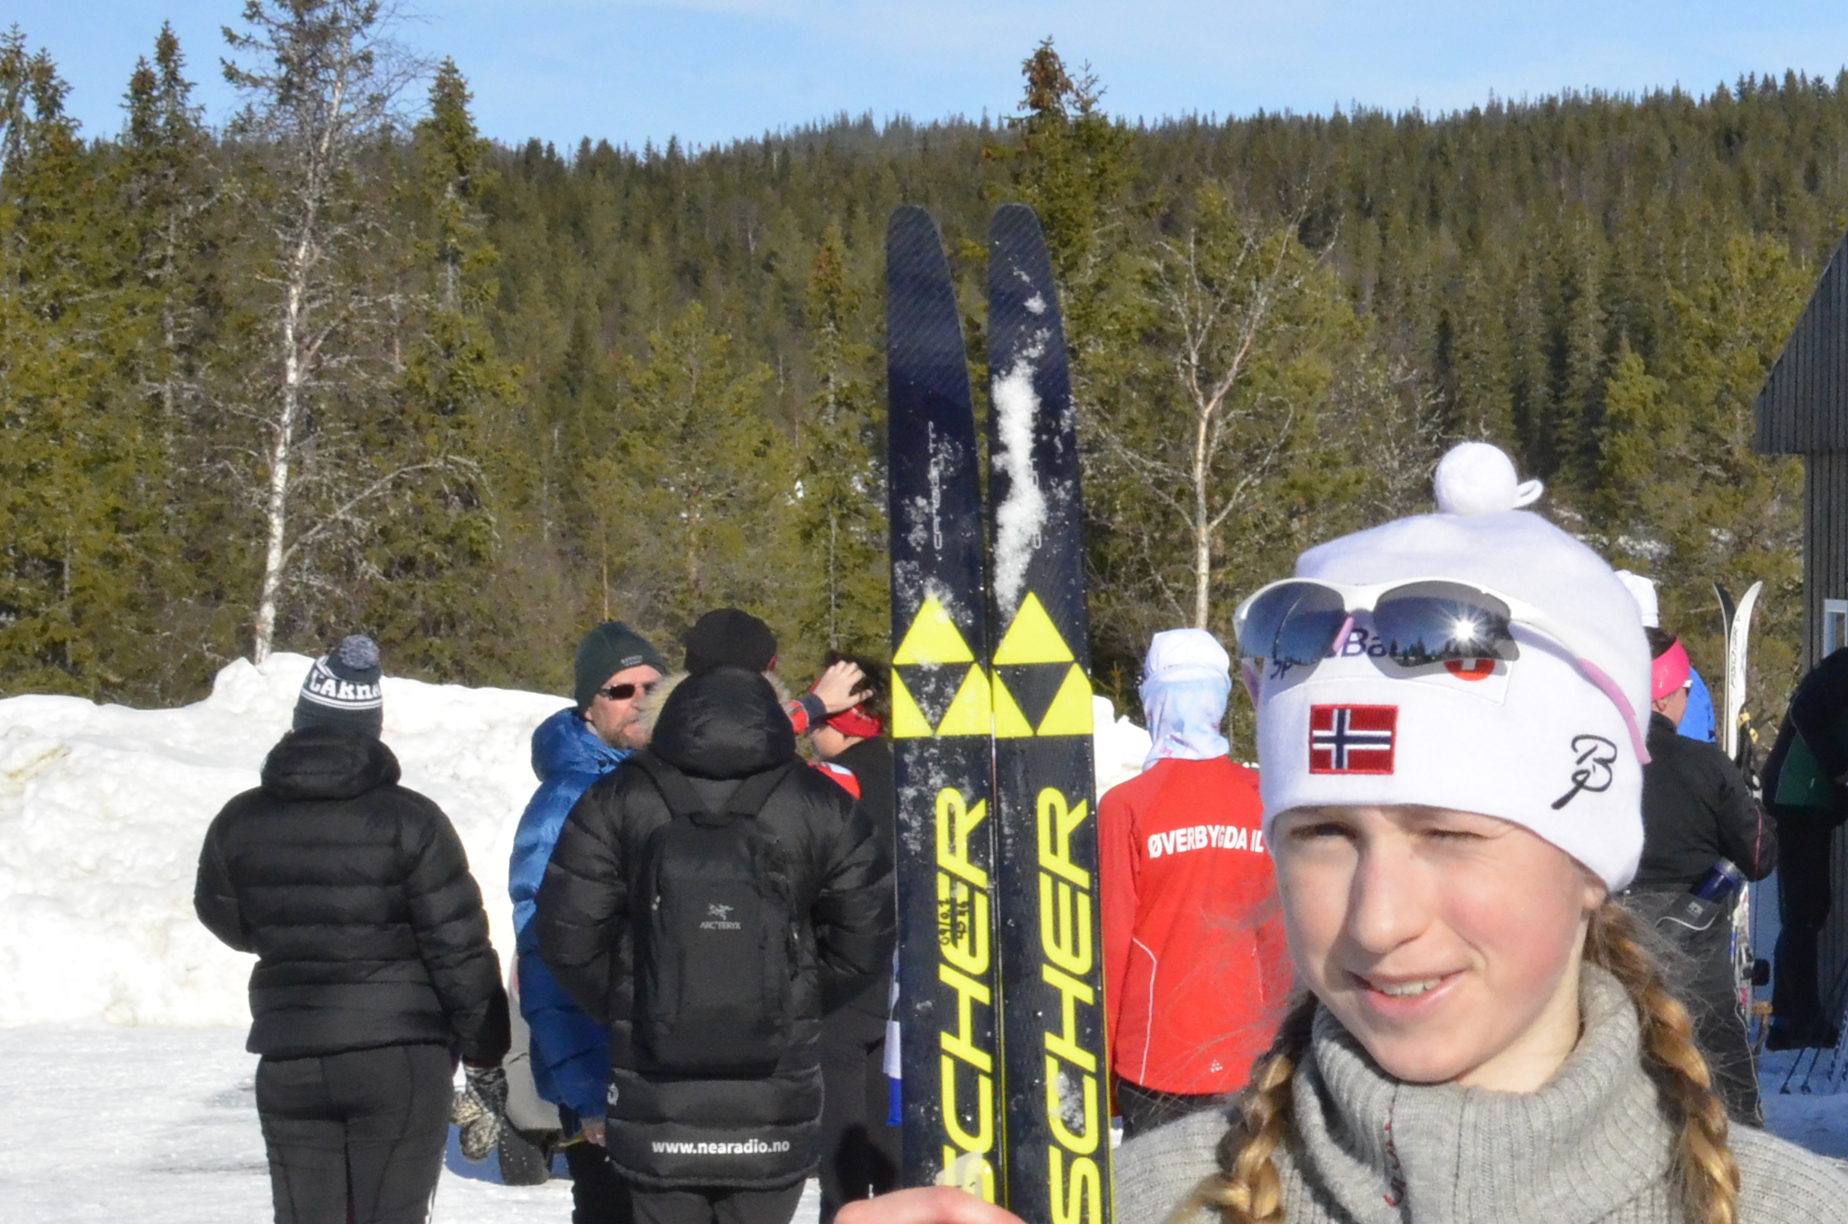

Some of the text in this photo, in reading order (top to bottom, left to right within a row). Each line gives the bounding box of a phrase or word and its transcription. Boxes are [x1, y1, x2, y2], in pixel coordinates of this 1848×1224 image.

[1147, 825, 1264, 858] ØVERBYGDA IL
[652, 1138, 790, 1154] www.nearadio.no
